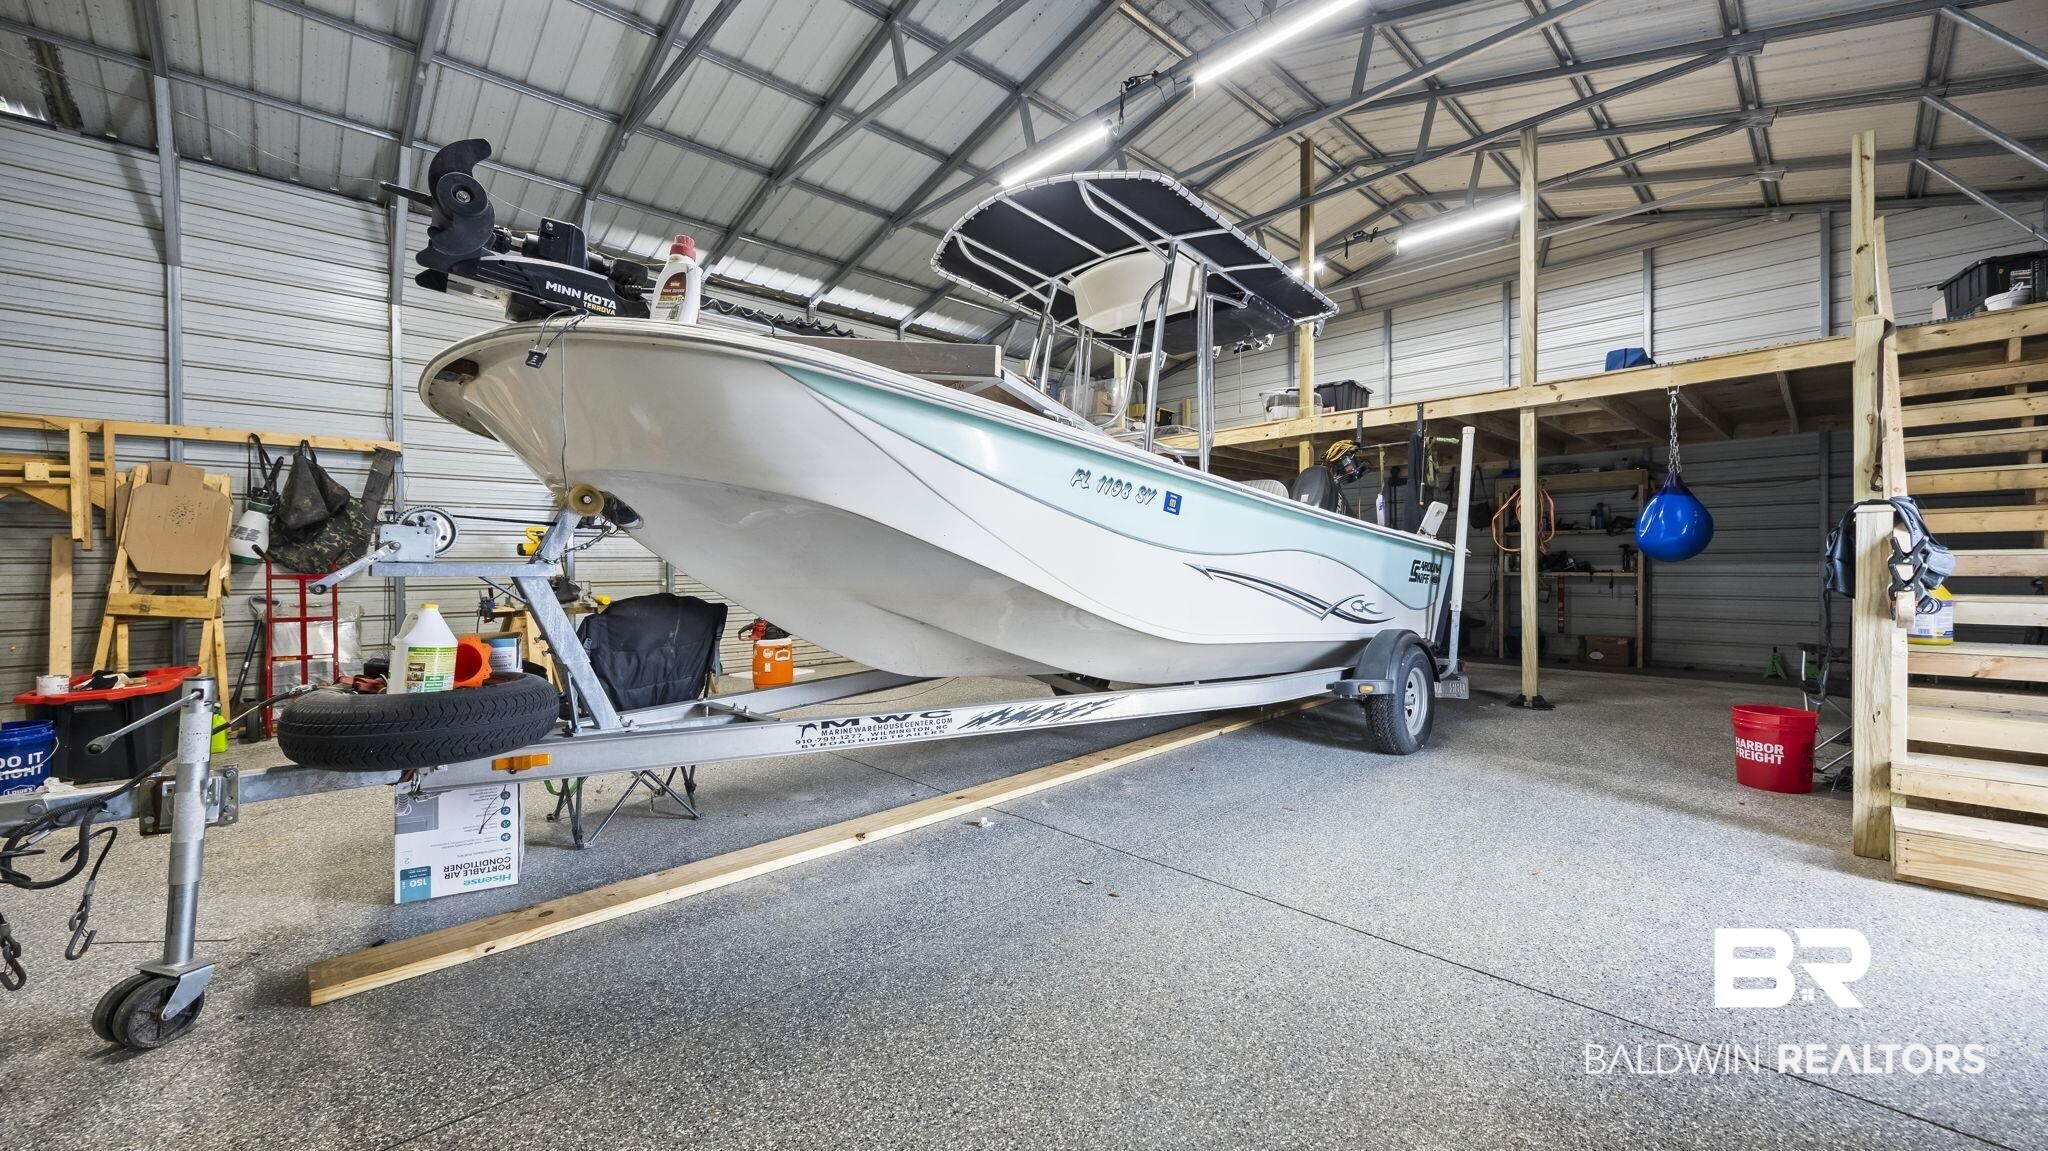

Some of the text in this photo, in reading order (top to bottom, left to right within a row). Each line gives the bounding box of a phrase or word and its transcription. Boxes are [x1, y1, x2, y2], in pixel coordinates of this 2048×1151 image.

[545, 280, 617, 310] MINN KOTA
[582, 300, 616, 316] TERROVA
[1070, 467, 1092, 489] FL
[1135, 485, 1158, 506] SV
[821, 717, 953, 737] MARINEWAREHOUSECENTER.COM
[795, 733, 862, 745] 910-799-1277
[1735, 736, 1785, 755] HARBOR
[28, 751, 44, 765] IT
[1735, 746, 1785, 765] FREIGHT
[443, 856, 511, 872] CONDITIONER
[444, 863, 511, 880] PORTABLE AIR
[409, 878, 428, 888] 150
[463, 873, 511, 887] Hisense
